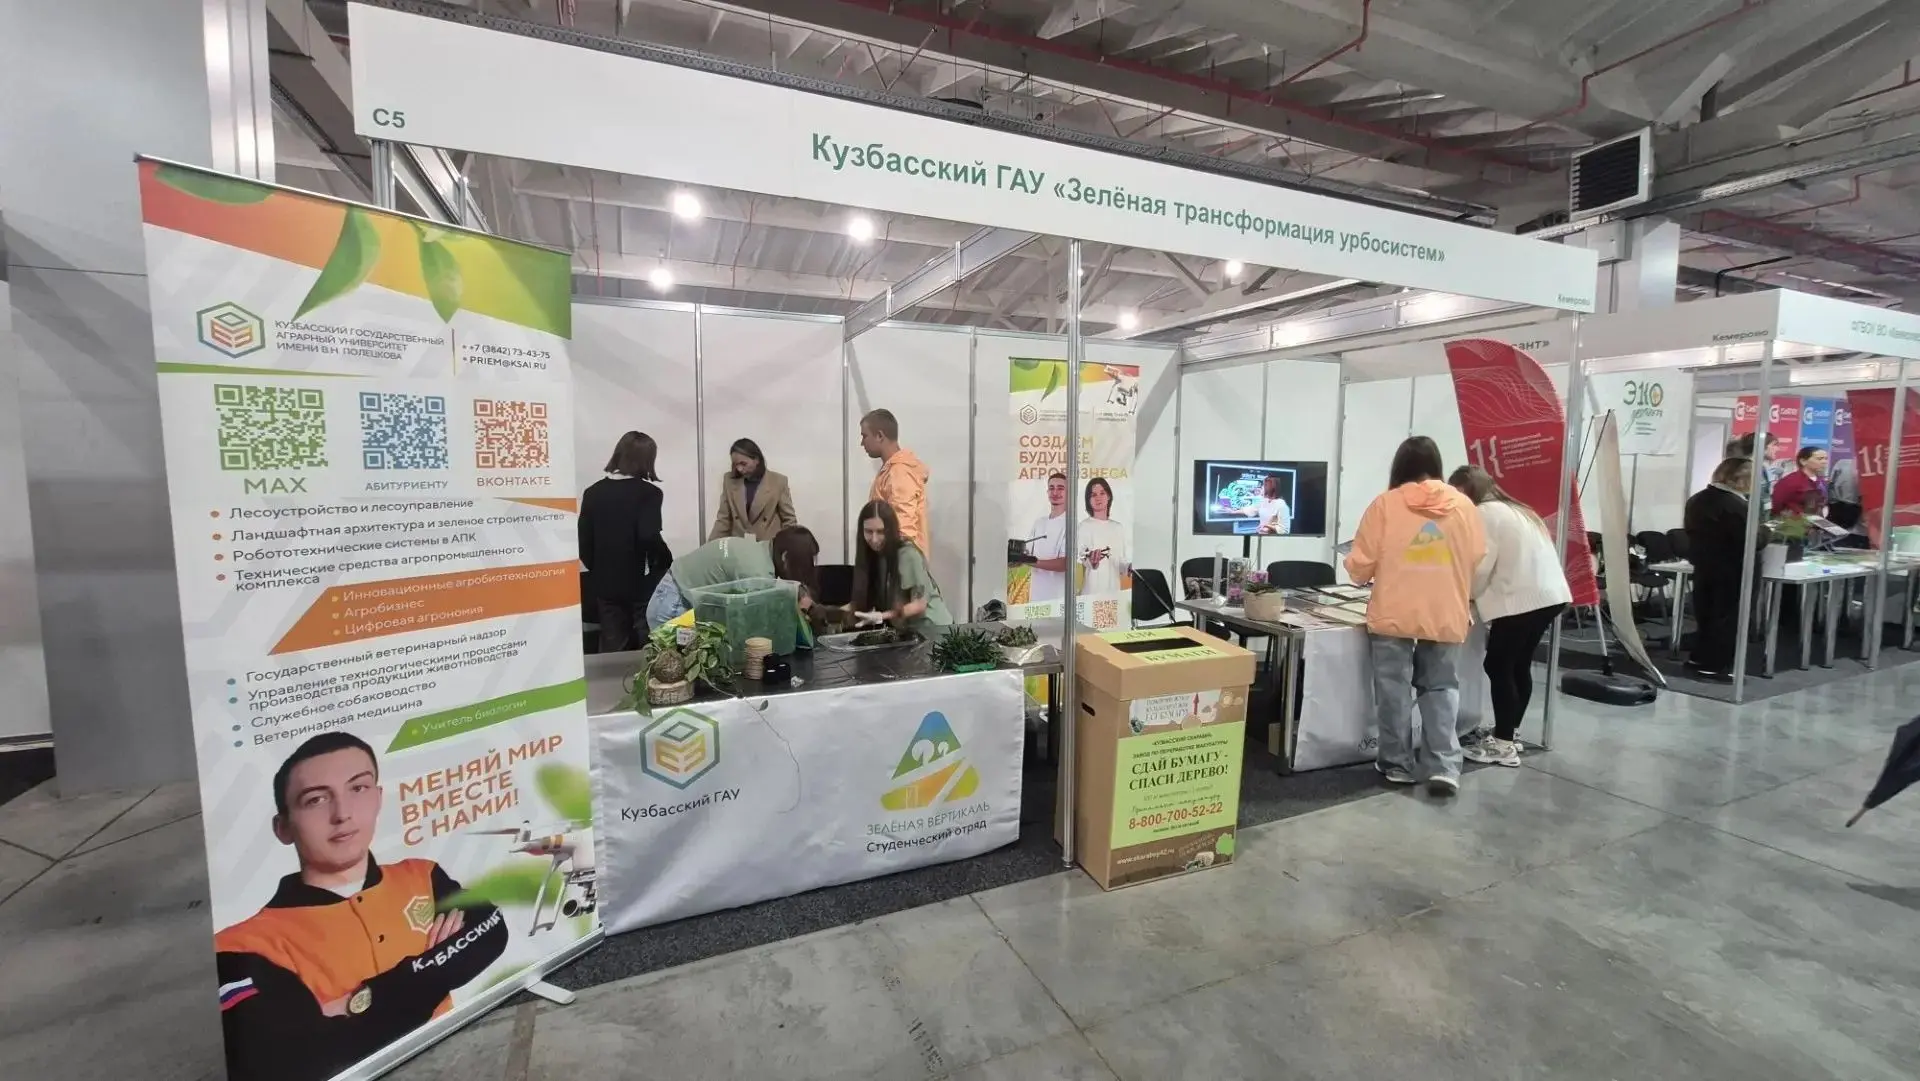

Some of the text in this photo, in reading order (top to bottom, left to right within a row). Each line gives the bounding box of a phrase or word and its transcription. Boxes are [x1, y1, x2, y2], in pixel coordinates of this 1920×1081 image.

[812, 132, 1445, 264] Кузбасский ГАУ «Зелёная трансформация урбосистем»
[274, 320, 445, 346] КУЗБАССКИЙ ГОСУДАРСТВЕННЫЙ
[276, 332, 408, 351] АГРАРНЫЙ УНИВЕРСИТЕТ
[1712, 328, 1769, 341] Кемерово
[276, 343, 319, 353] ИМЕНИ
[343, 348, 402, 361] ПОЛЕЦКОВА
[469, 356, 547, 370] PRIEM@KSAI.RU
[482, 345, 511, 356] (3842)
[513, 348, 551, 359] 73-43-75
[244, 477, 307, 495] MAX
[365, 480, 448, 492] АБИТУРИЕНТУ
[476, 476, 552, 488] ВКОНТАКТЕ
[229, 499, 474, 520] Лесоустройство и лесоуправление
[231, 512, 565, 542] Ландшафтная архитектура и зеленое строительство
[232, 541, 382, 562] Робототехнические
[384, 537, 440, 550] системы
[451, 532, 477, 544] АПК
[235, 546, 524, 582] Технические средства агропромышленного
[236, 575, 320, 593] комплекса
[343, 566, 566, 602] Инновационные агробиотехнологии
[343, 599, 425, 620] Агробизнес
[345, 604, 484, 637] Цифровая агрономия
[246, 627, 507, 684] Государственный ветеринарный надзор
[1145, 649, 1217, 662] БУМАГИ
[248, 639, 528, 702] Управление технологическими процессами
[249, 648, 519, 711] производства продукции животноводства
[251, 679, 437, 729] Служебное собаководство
[254, 700, 423, 747] Ветеринарная медицина
[422, 715, 473, 737] Учитель
[399, 735, 563, 801] МЕНЯЙ МИР
[1129, 764, 1229, 791] СПАСИ ДЕРЕВО!
[1132, 757, 1167, 775] СДАЙ
[1171, 751, 1221, 768] БУМАГУ
[402, 770, 513, 826] ВМЕСТЕ
[621, 788, 741, 822] Кузбасский ГАУ
[403, 789, 520, 847] С НАМИ!
[866, 800, 991, 836] ЗЕЛЁНАЯ ВЕРТИКАЛЬ
[1129, 801, 1223, 830] 8-800-700-52-22
[866, 817, 988, 854] Студенческий отряд
